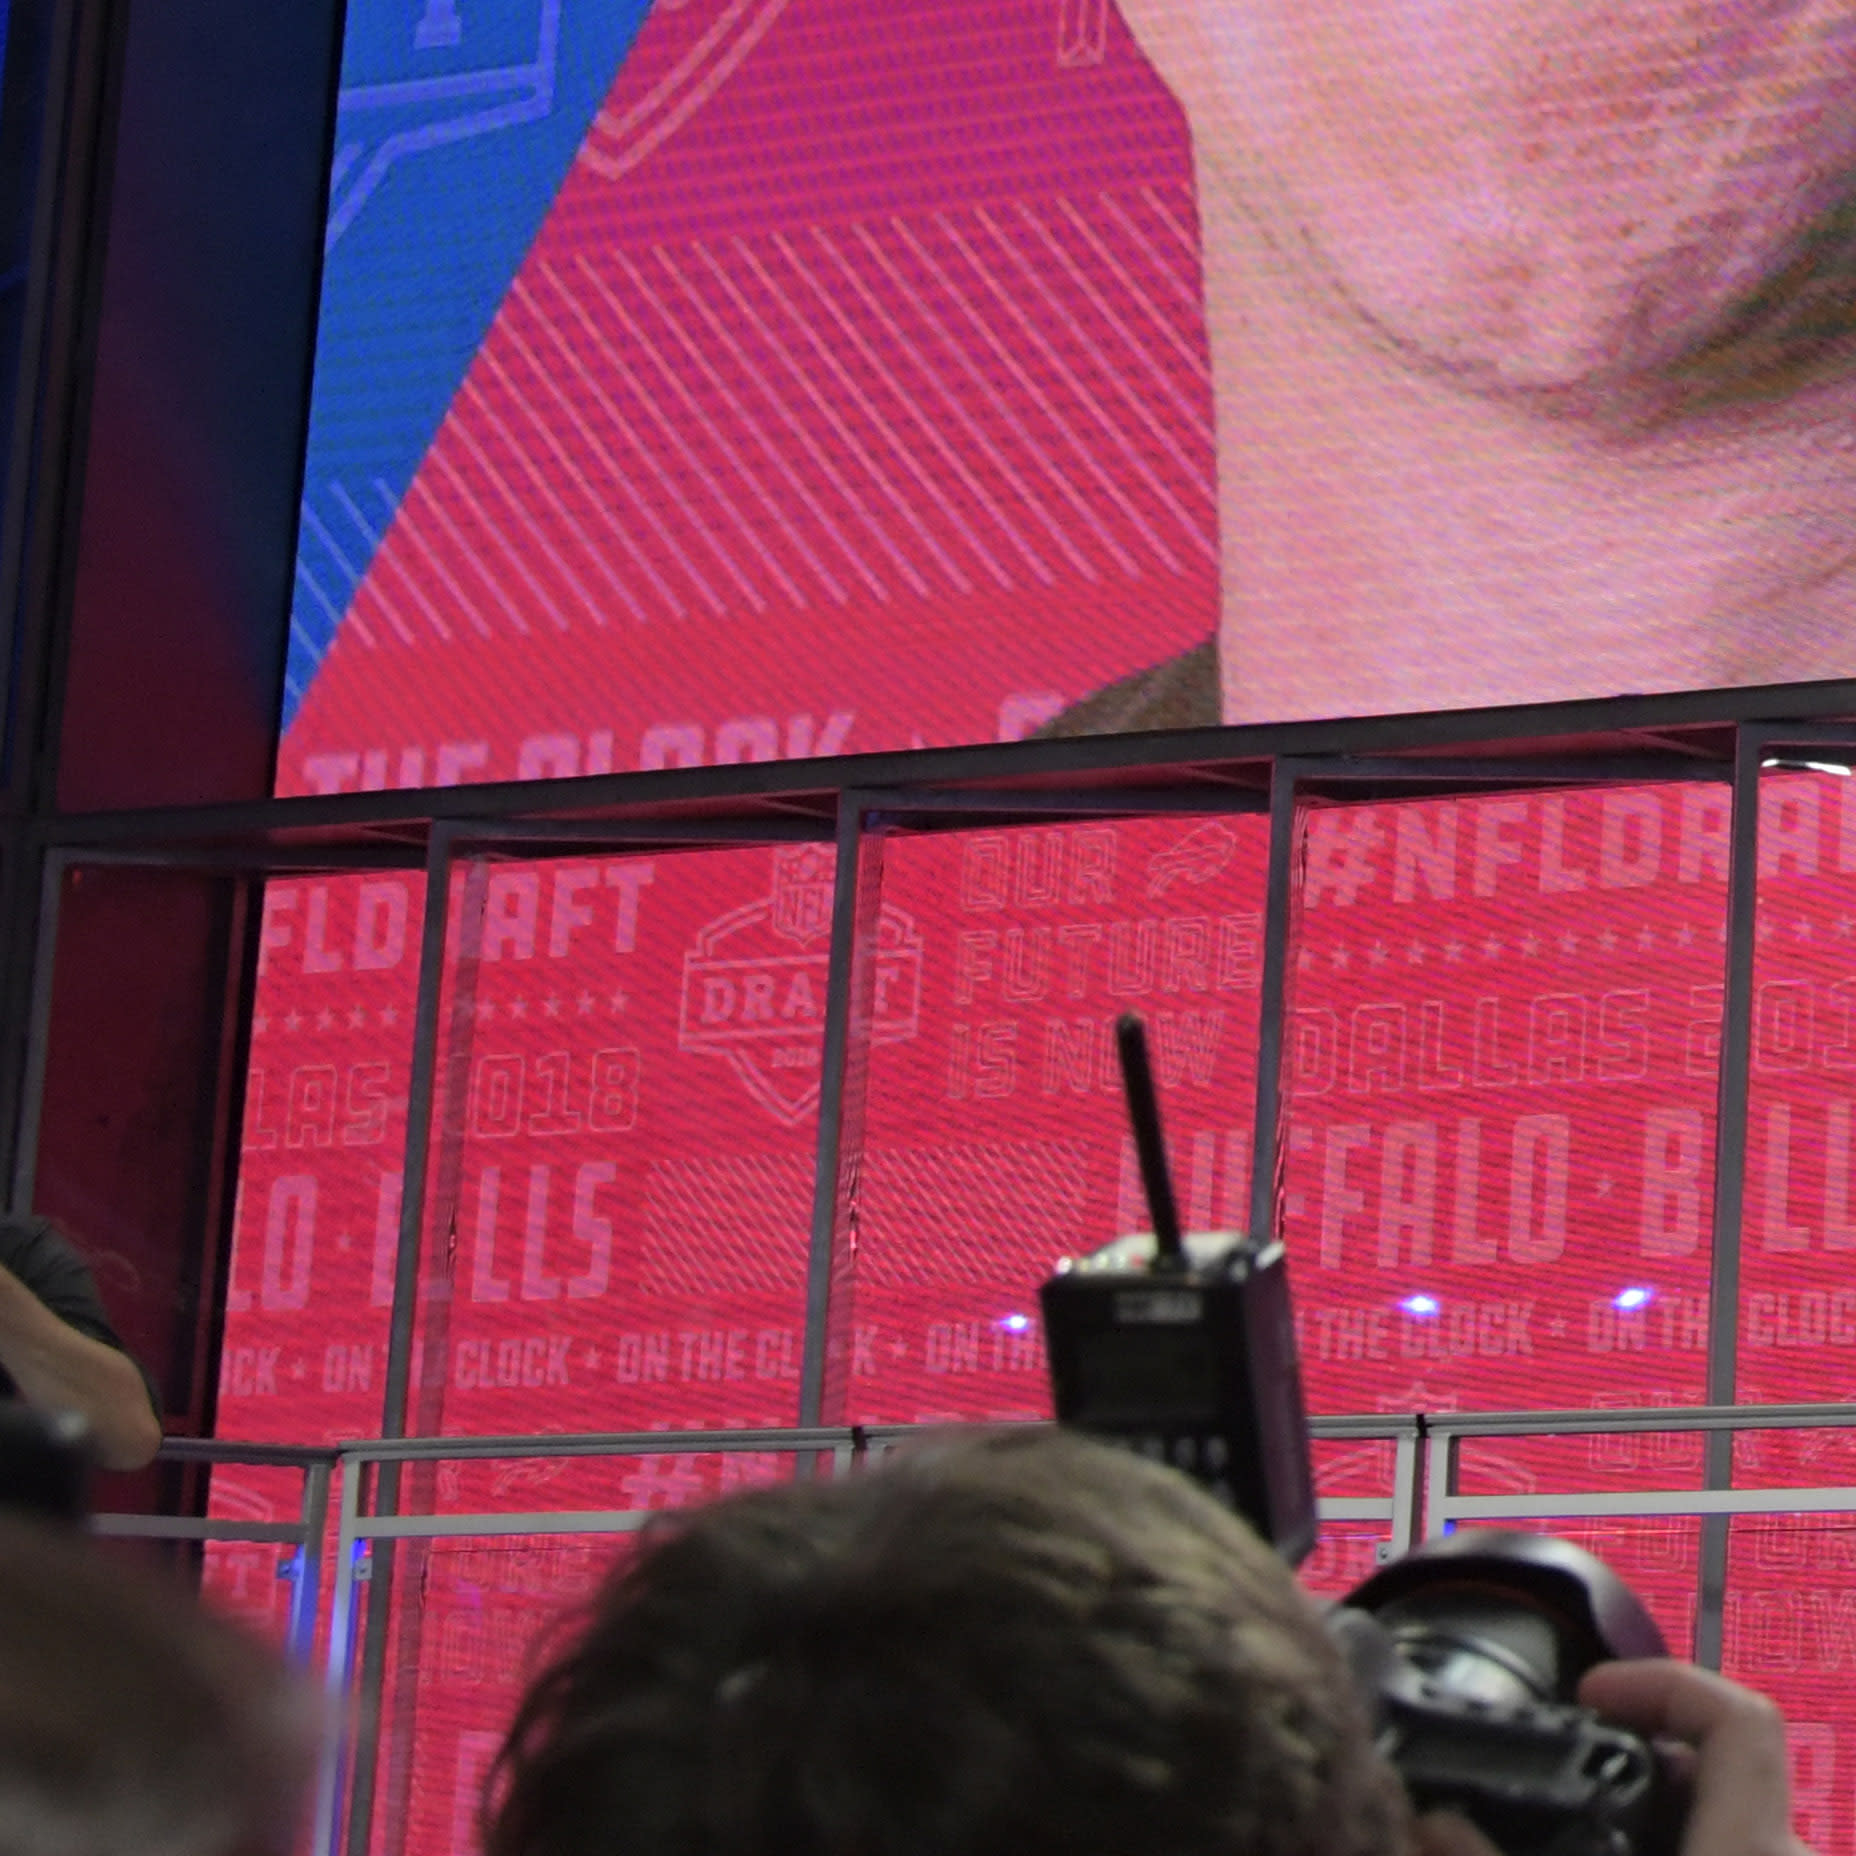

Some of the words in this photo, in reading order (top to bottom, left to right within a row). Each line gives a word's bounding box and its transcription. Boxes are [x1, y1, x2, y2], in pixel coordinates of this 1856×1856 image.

[455, 1335, 570, 1390] CLOCK
[616, 1332, 670, 1385] ON
[678, 1328, 750, 1382] THE
